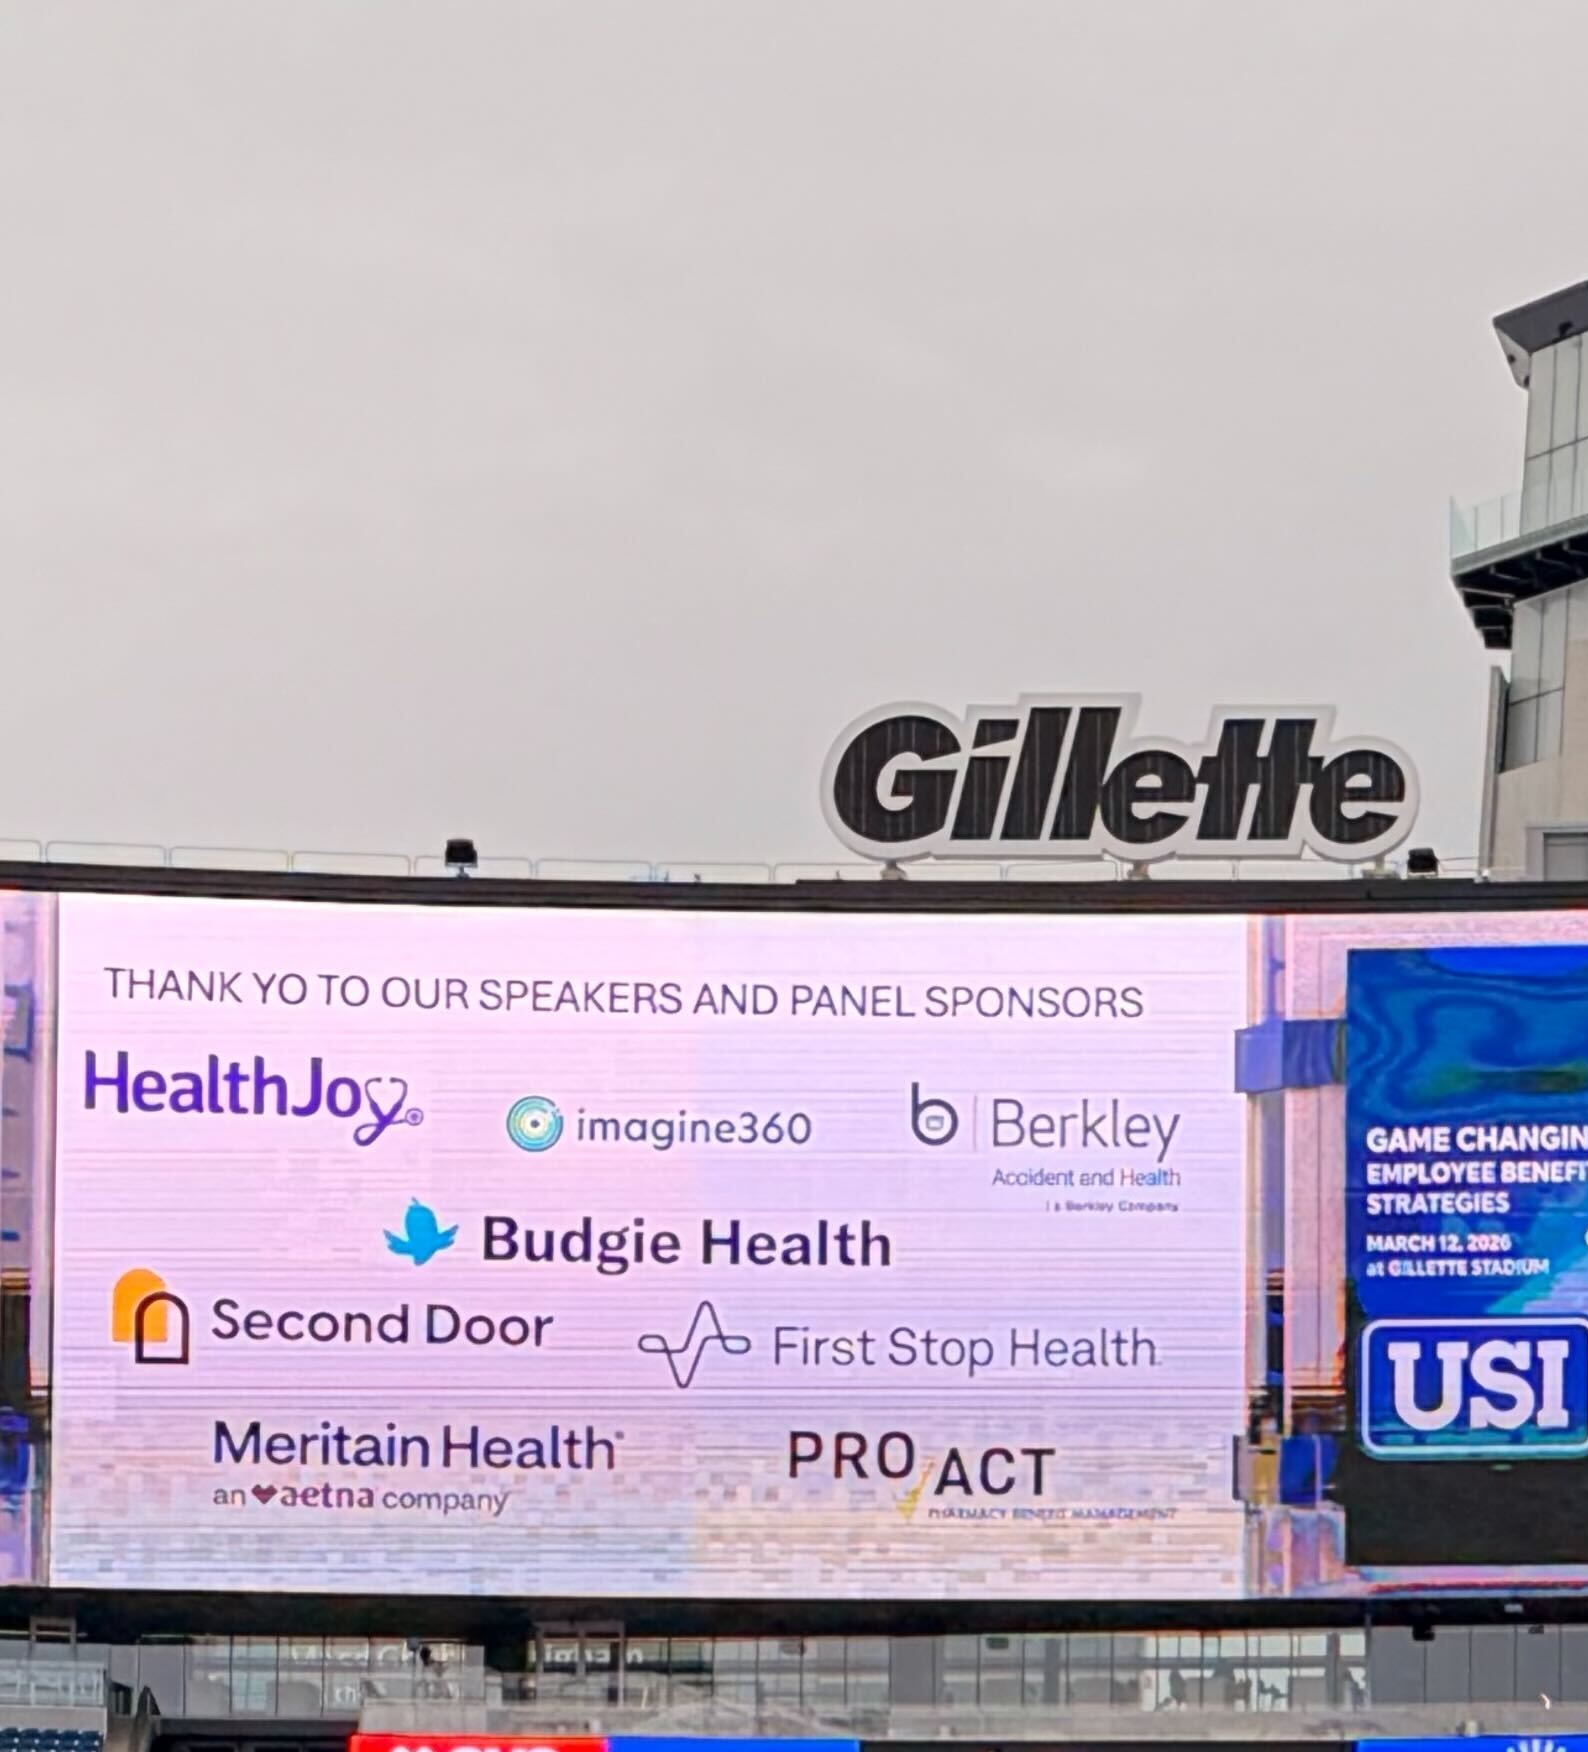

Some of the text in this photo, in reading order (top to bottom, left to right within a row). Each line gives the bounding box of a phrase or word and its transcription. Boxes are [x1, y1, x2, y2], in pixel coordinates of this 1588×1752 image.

[833, 706, 1406, 844] Gillette
[104, 967, 1144, 1018] THANK YO TO OUR SPEAKERS AND PANEL SPONSORS
[83, 1049, 424, 1147] HealthJoy
[576, 1109, 812, 1151] imagine360
[992, 1099, 1181, 1163] Berkley
[1366, 1126, 1451, 1153] GAME
[991, 1168, 1182, 1187] Accident and Health
[1366, 1161, 1497, 1185] EMPLOYEE
[1366, 1191, 1511, 1216] STRATEGIES
[483, 1216, 892, 1274] Budgie Health
[1366, 1234, 1436, 1252] MARCH
[1466, 1234, 1512, 1252] 2026
[1366, 1258, 1549, 1277] at GILLETTE STADIUM
[211, 1298, 554, 1346] Second Door
[774, 1326, 1156, 1378] First Stop Health
[1387, 1339, 1570, 1430] USI
[213, 1420, 616, 1470] Meritain Health
[213, 1483, 509, 1515] an aetna company
